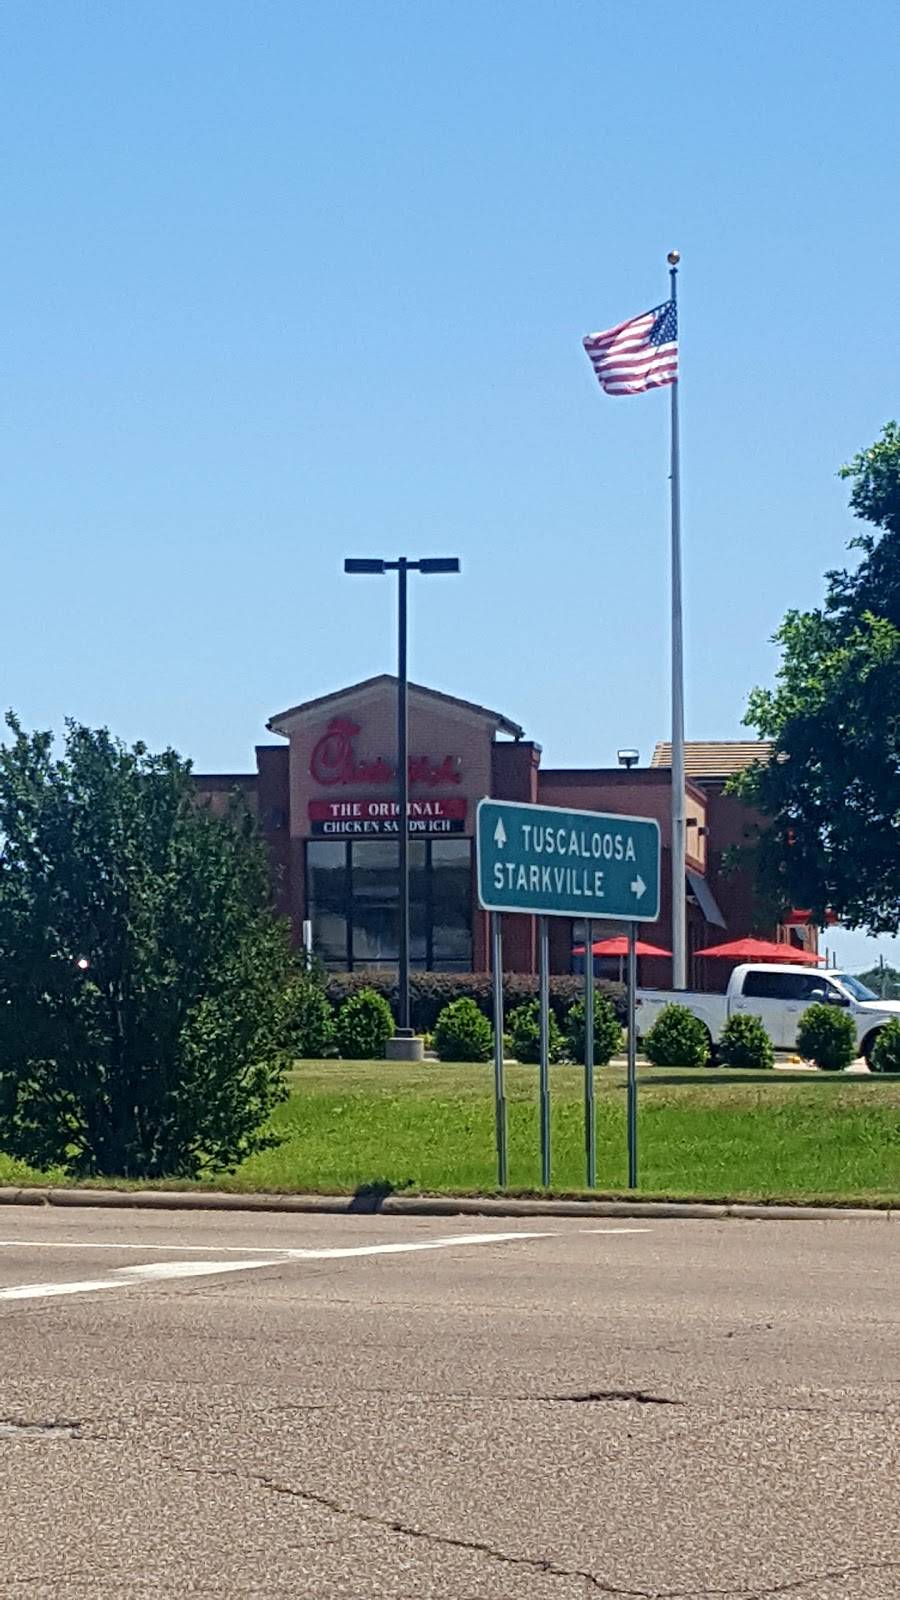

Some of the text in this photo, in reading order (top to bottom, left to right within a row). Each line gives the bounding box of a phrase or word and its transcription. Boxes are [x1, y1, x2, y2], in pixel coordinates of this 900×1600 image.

[330, 803, 361, 817] THE
[323, 819, 451, 833] CHICKEN SADWICH
[522, 825, 636, 862] TUSCALOOSA
[494, 863, 605, 898] STARKVILLE
